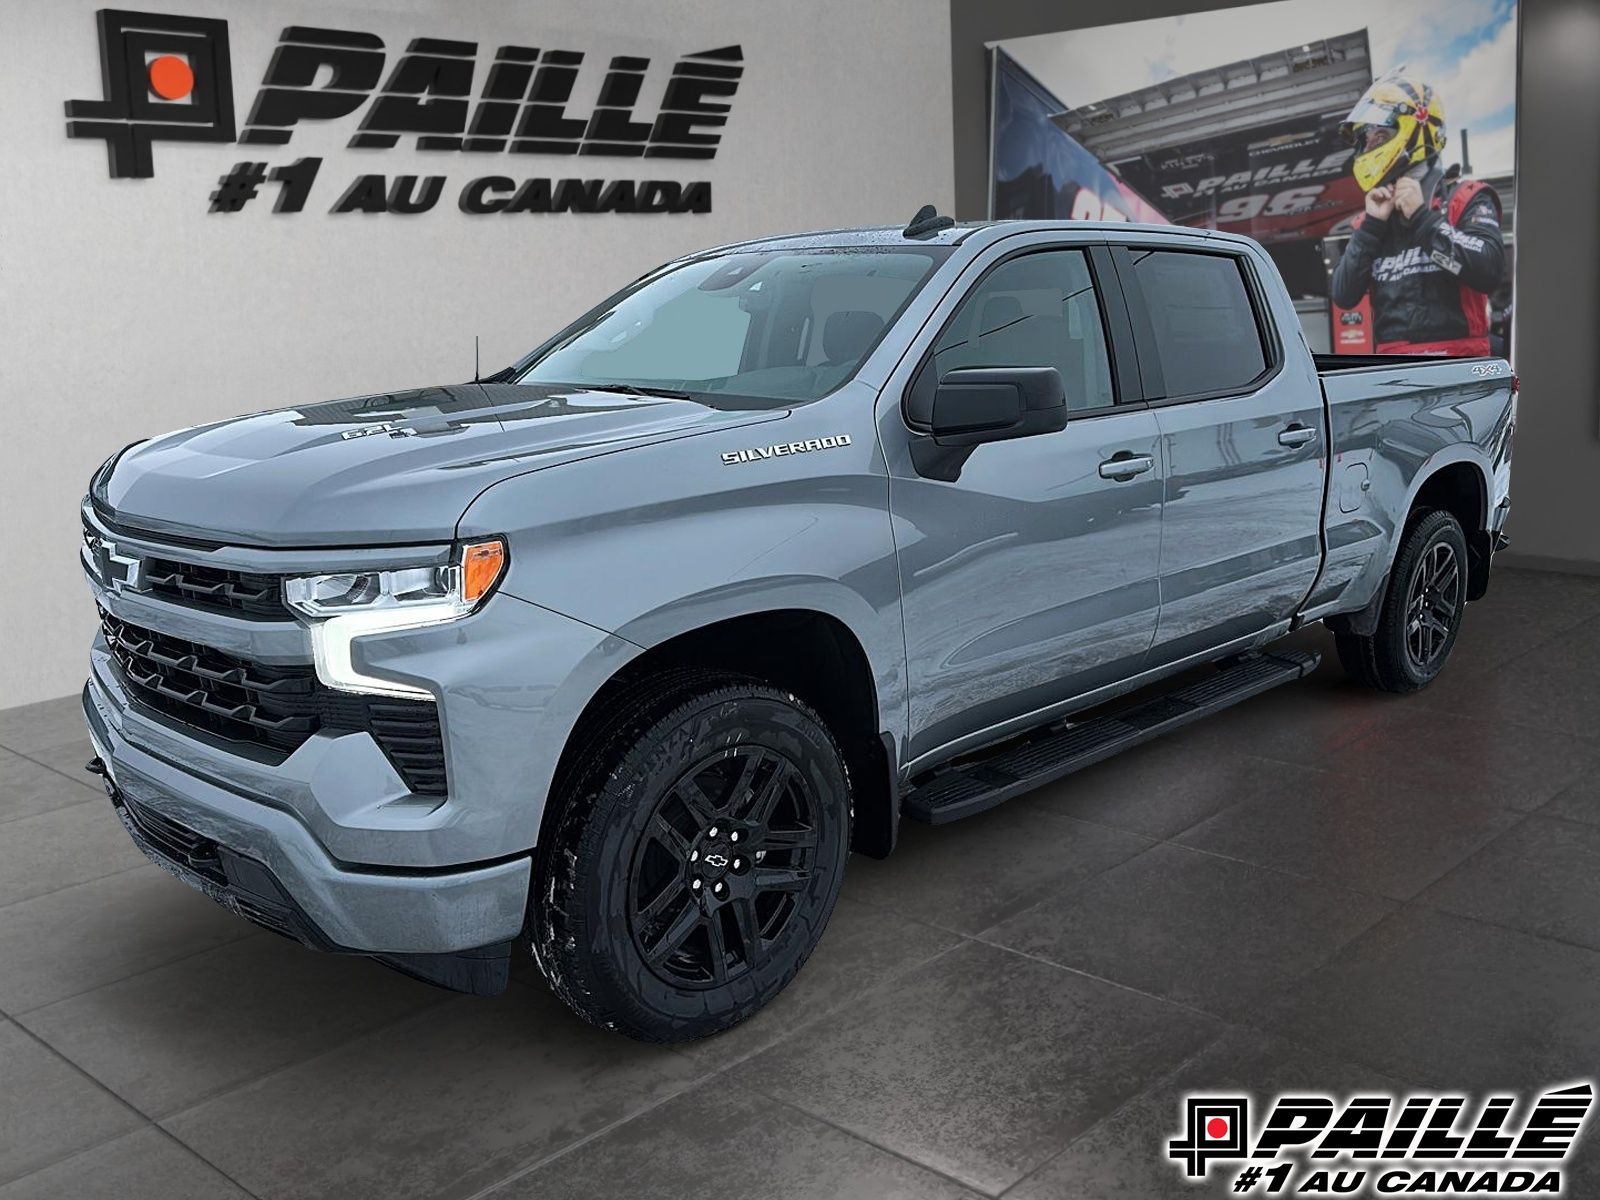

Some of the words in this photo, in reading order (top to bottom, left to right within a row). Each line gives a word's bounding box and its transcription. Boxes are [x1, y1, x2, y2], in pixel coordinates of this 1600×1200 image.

[237, 26, 744, 159] PAILLÉ
[208, 157, 322, 213] #1
[329, 175, 447, 214] AU
[457, 176, 712, 214] CANADA
[1254, 167, 1342, 187] CANADA
[1216, 185, 1325, 223] 96
[721, 434, 852, 466] SILVERADO
